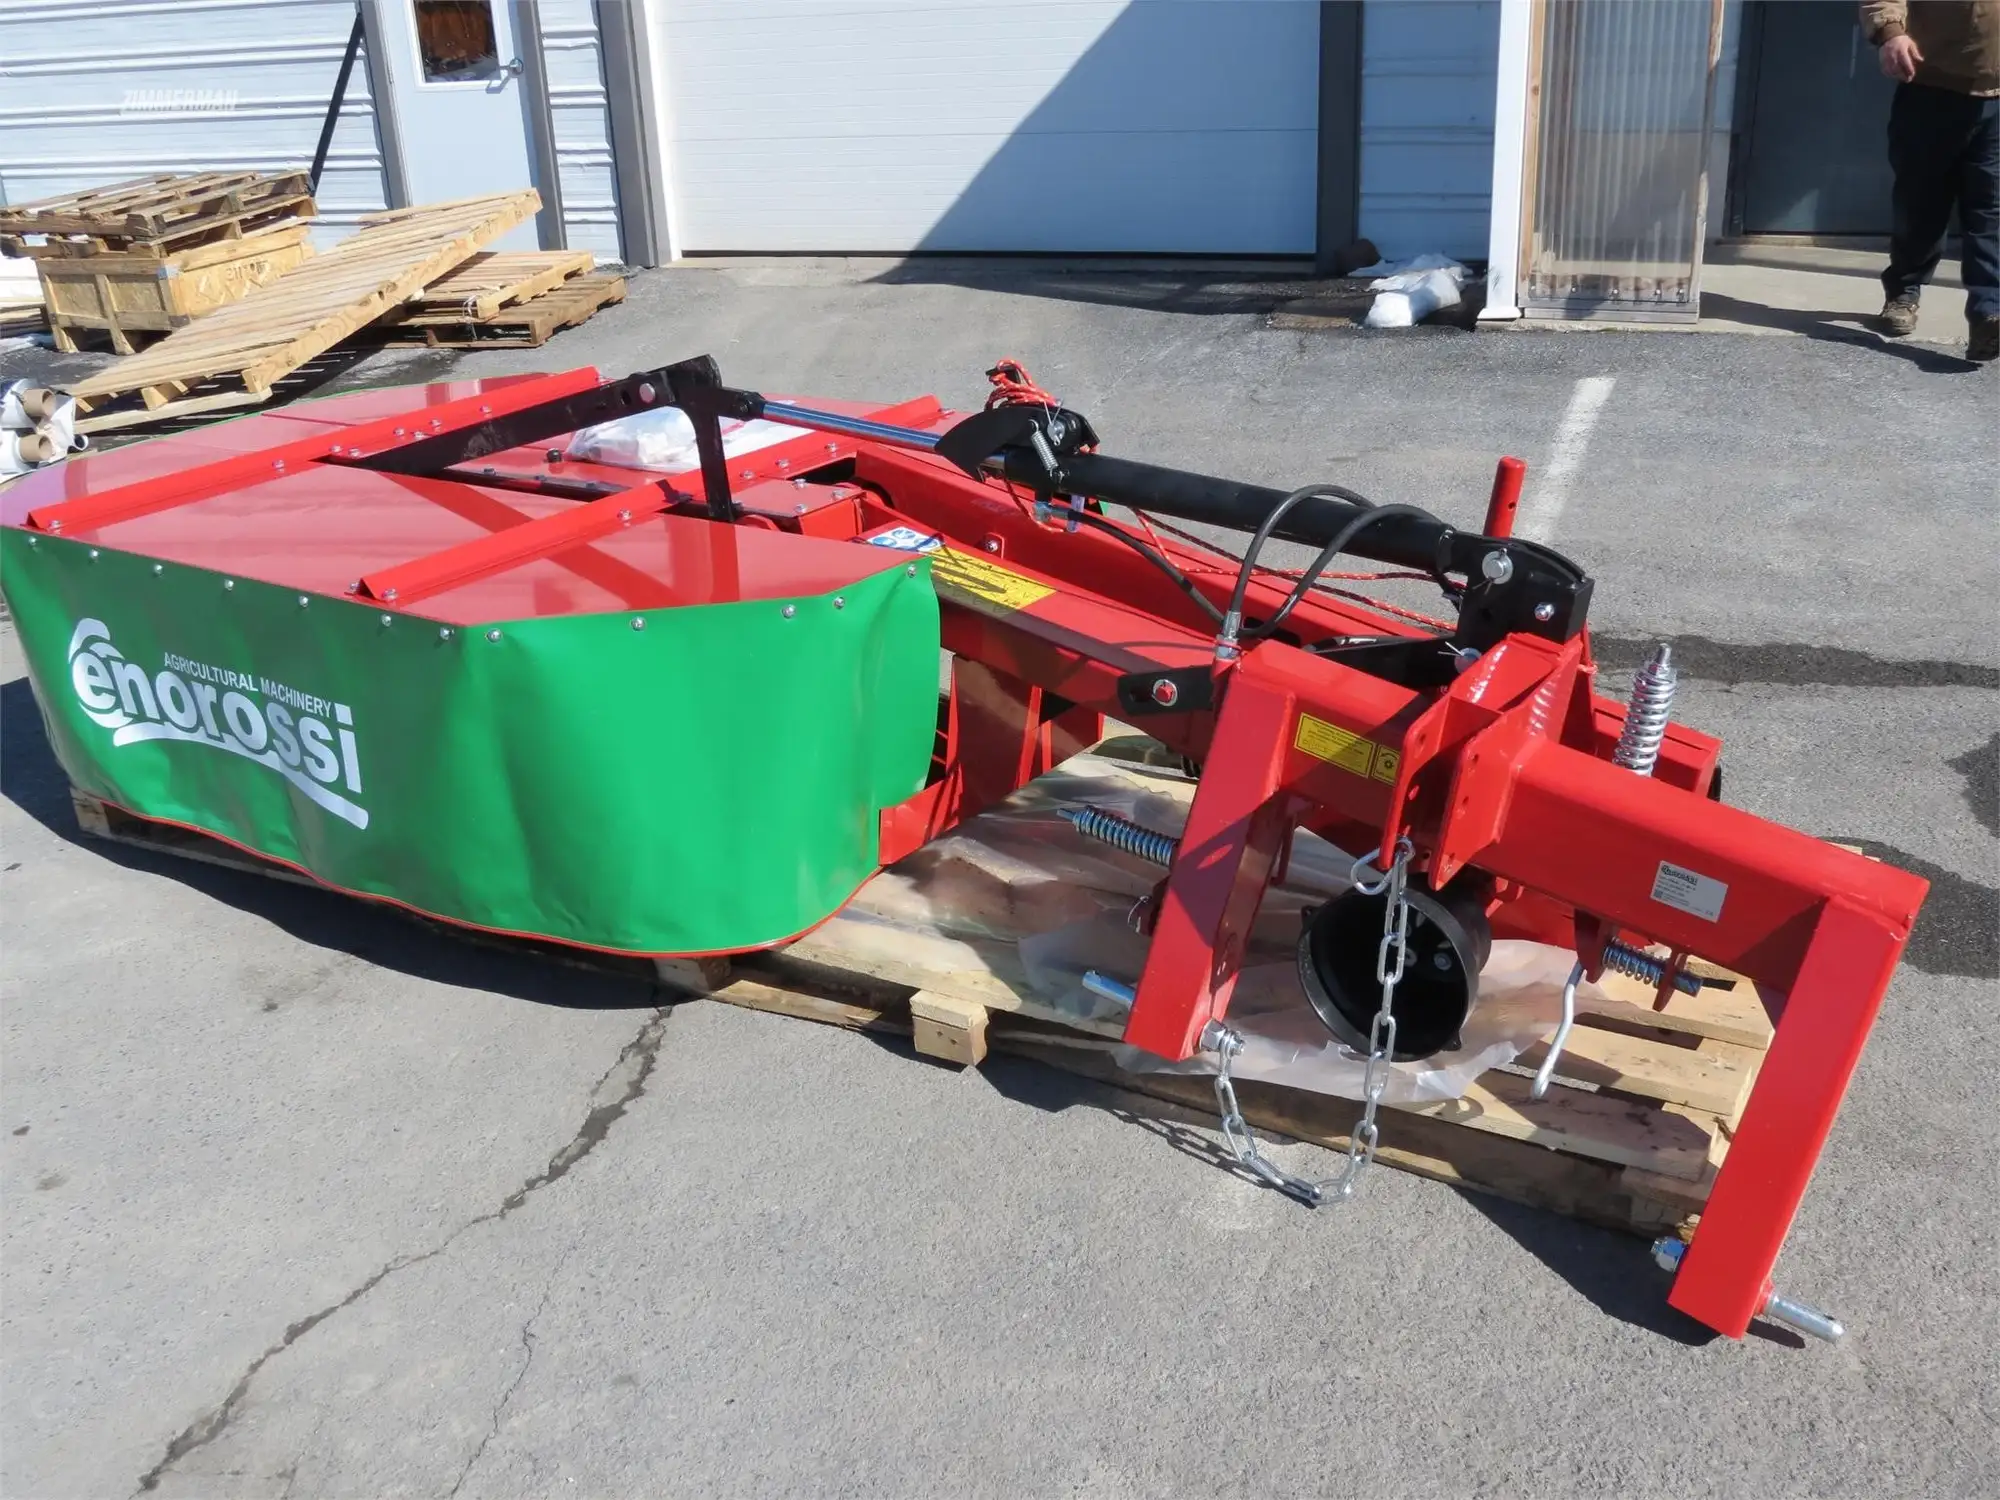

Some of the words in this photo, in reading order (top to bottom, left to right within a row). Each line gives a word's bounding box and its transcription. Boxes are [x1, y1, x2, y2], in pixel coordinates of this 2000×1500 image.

[71, 650, 362, 794] enorossi
[163, 651, 259, 693] AGRICULTURAL
[260, 676, 332, 719] MACHINERY
